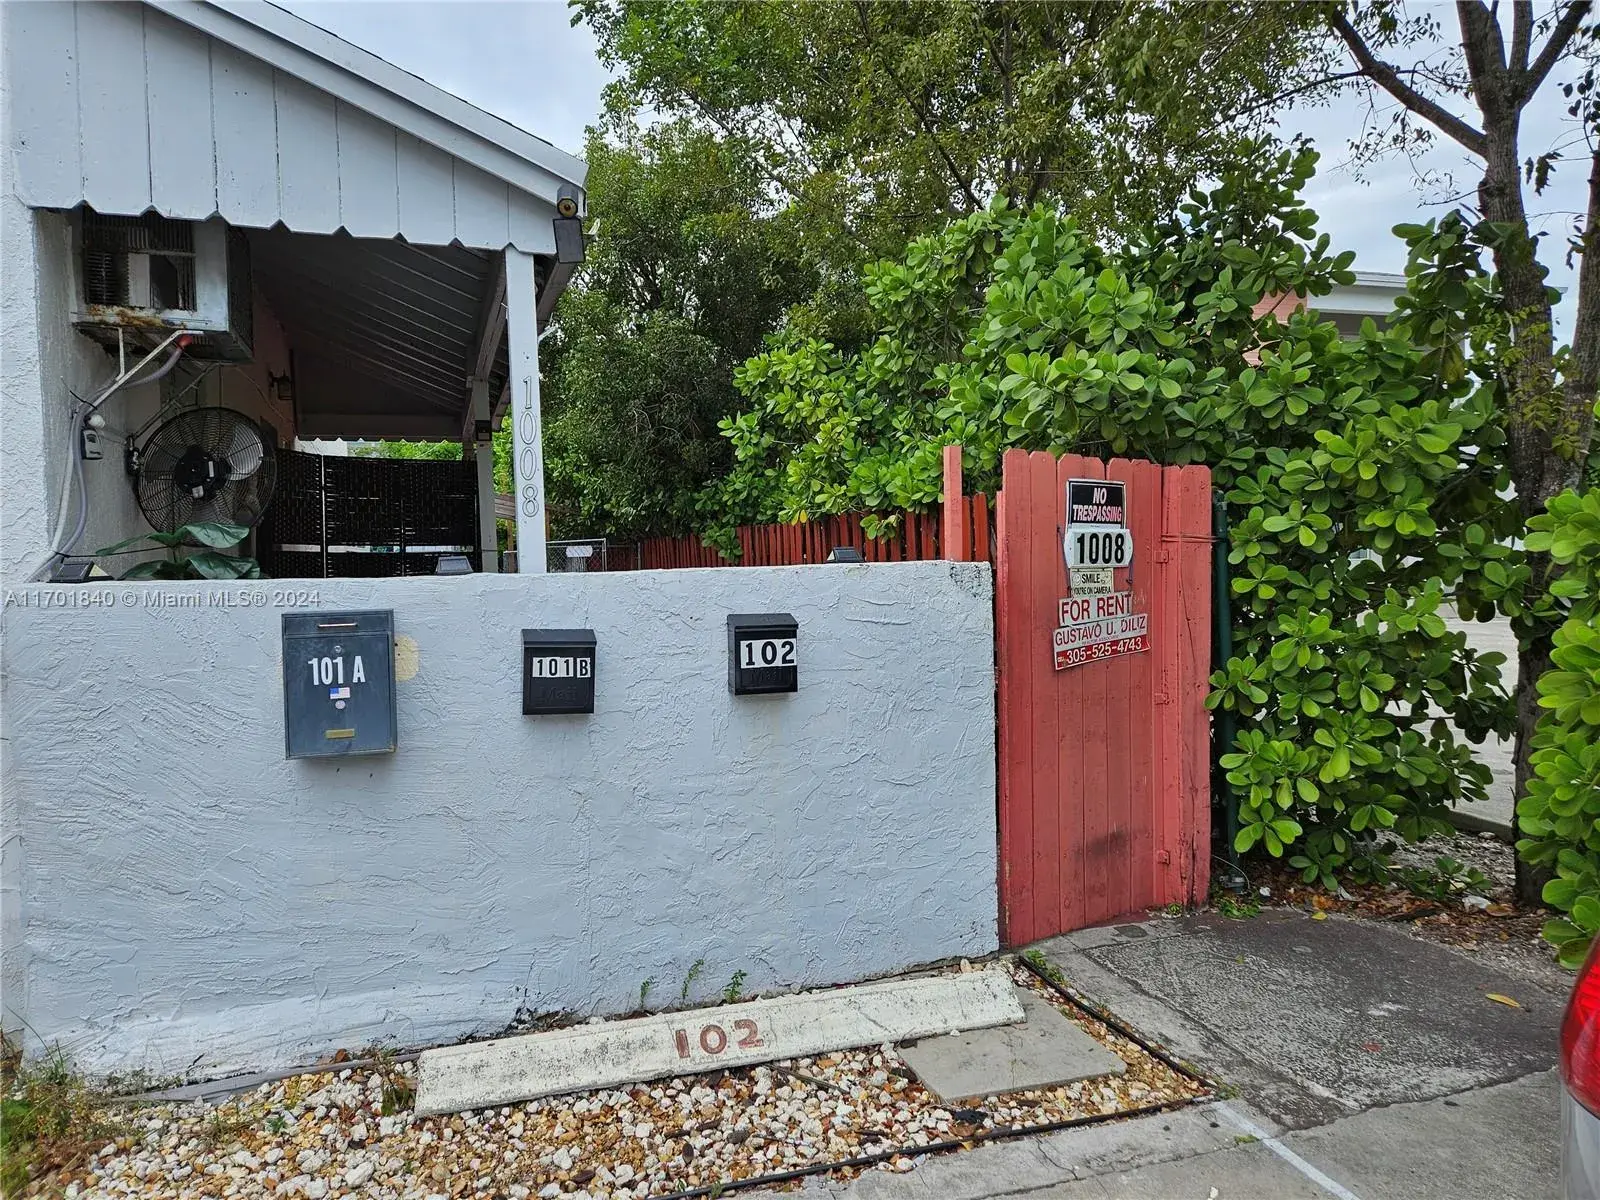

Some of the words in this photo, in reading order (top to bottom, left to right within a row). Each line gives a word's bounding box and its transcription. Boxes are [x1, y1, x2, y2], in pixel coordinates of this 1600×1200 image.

[519, 375, 539, 517] 1008
[1093, 487, 1107, 504] NO
[1073, 504, 1122, 522] TRESPASSING
[1077, 533, 1124, 564] 1008
[1081, 573, 1101, 584] SMILE
[1087, 586, 1094, 595] ON
[1094, 586, 1112, 594] CAMERA
[1061, 599, 1090, 624] FOR
[1097, 594, 1131, 617] RENT
[1055, 623, 1102, 646] GUSTAVO
[1106, 617, 1117, 636] U.
[1121, 616, 1146, 633] DILIZ
[745, 640, 795, 666] 102
[1066, 637, 1142, 664] 305-525-4743
[308, 656, 344, 685] 101
[352, 656, 366, 683] A
[675, 1018, 765, 1058] 102
